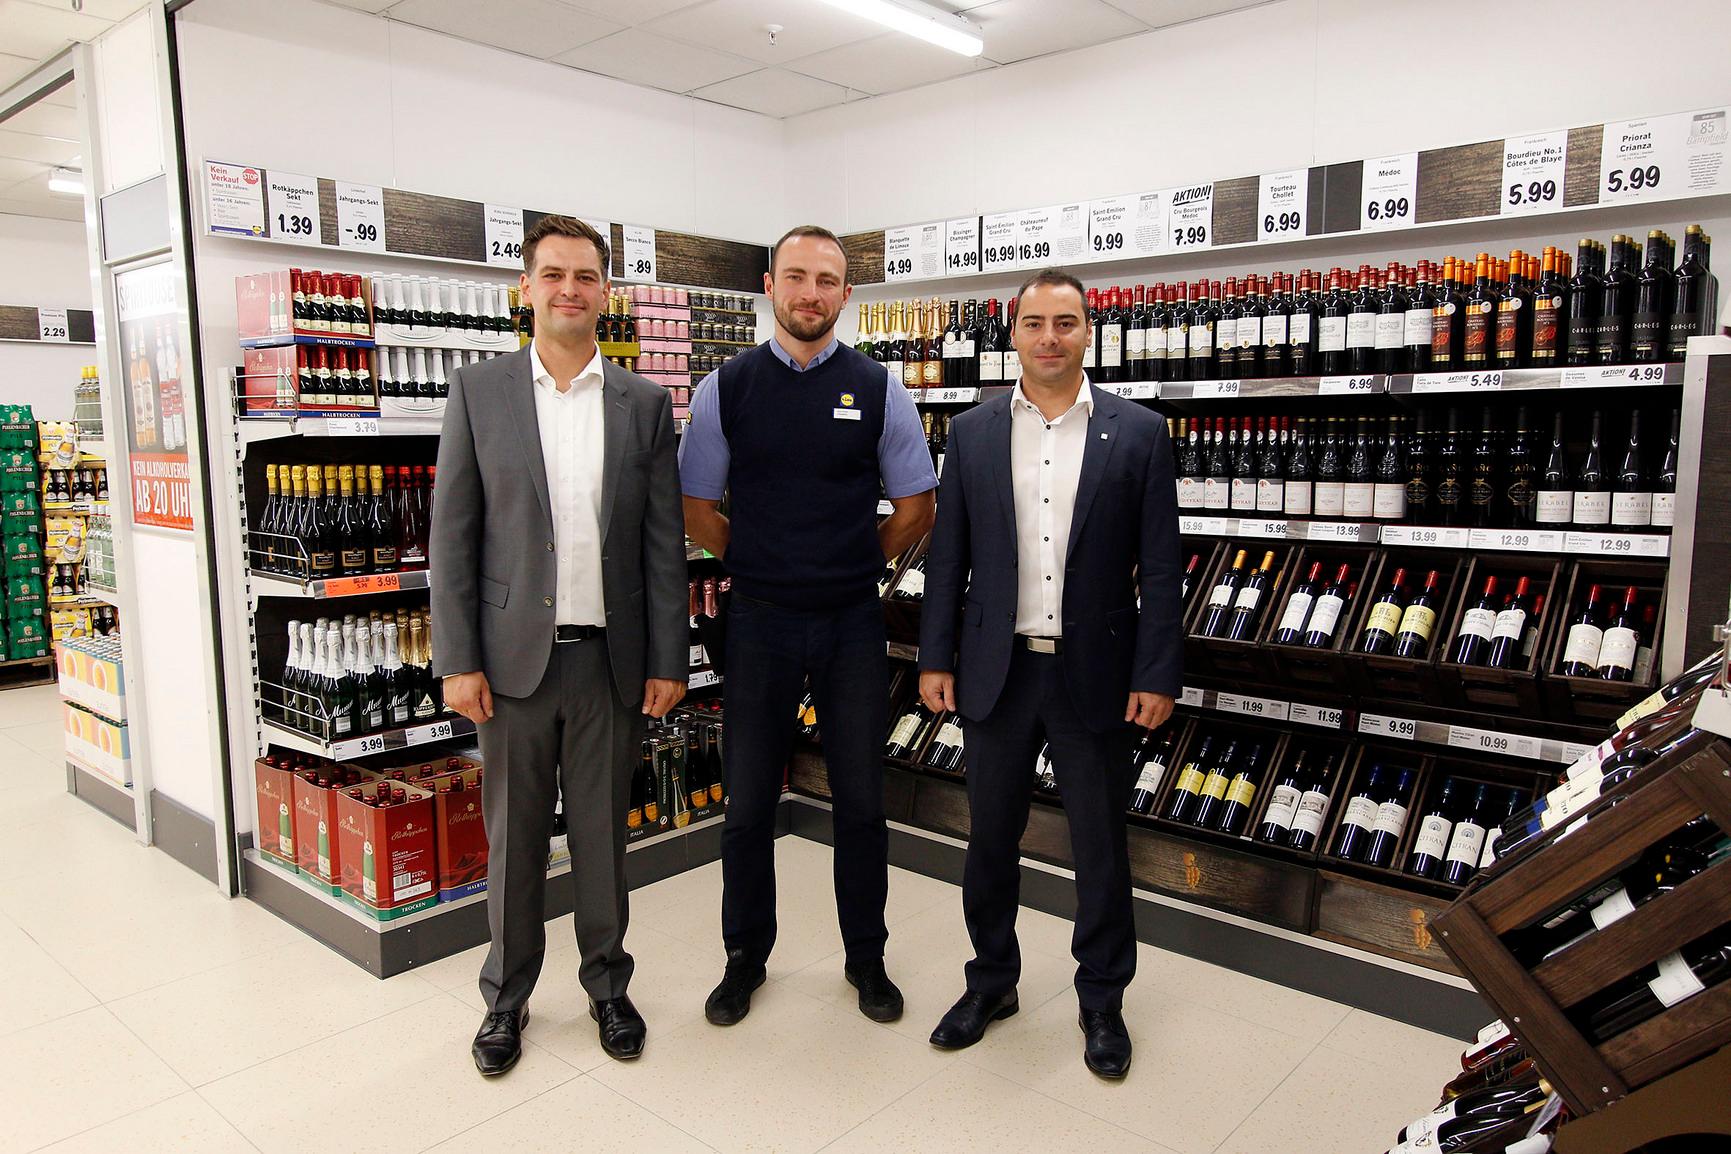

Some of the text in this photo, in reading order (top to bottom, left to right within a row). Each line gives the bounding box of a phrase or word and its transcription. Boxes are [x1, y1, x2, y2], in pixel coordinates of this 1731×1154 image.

[1622, 132, 1652, 142] Priorat
[1620, 143, 1652, 152] Crianza
[1507, 149, 1541, 160] Bourdieu
[1506, 159, 1527, 168] Côtes
[1541, 155, 1562, 164] Blaye
[210, 166, 228, 175] Kein
[210, 174, 240, 184] Verkauf
[1607, 165, 1661, 193] 5.99
[272, 184, 314, 196] Rotkäppchen
[1270, 184, 1297, 192] Tourteau
[1508, 180, 1556, 205] 5.99
[286, 193, 301, 201] Sekt
[1172, 185, 1212, 204] AKTION!
[1272, 191, 1294, 199] Chollet
[1092, 206, 1125, 216] Saint Emilion
[1183, 205, 1208, 214] Bourgeois
[1368, 197, 1409, 220] 6.99
[278, 213, 313, 236] 1.39
[1264, 211, 1300, 233] 6.99
[345, 223, 377, 242] -.99
[1174, 226, 1206, 246] 7.99
[1094, 232, 1123, 251] 9.99
[492, 241, 521, 259] 2.49
[984, 245, 1014, 263] 19.99
[1018, 241, 1050, 260] 16.99
[948, 251, 977, 268] 14.99
[628, 259, 652, 274] -.89
[888, 258, 912, 275] 4.99
[43, 326, 66, 337] 2.29
[317, 338, 355, 346] HALBTROCKEN
[1470, 373, 1501, 387] 5.49
[1628, 367, 1663, 381] 4.99
[1218, 382, 1238, 393] 7.99
[1349, 378, 1373, 390] 6.99
[943, 391, 957, 400] 8.99
[1116, 387, 1132, 397] 7.99
[354, 422, 377, 433] 3.79
[136, 479, 151, 513] AB
[153, 480, 168, 515] 20
[1183, 521, 1203, 531] 15.99
[1264, 523, 1287, 533] 15.99
[1336, 525, 1360, 536] 13.99
[1411, 531, 1437, 541] 13.99
[1500, 535, 1529, 546] 12.99
[1600, 539, 1631, 551] 12.99
[377, 575, 397, 587] 3.99
[1242, 700, 1263, 713] 11.99
[1317, 709, 1341, 724] 11.99
[430, 724, 451, 738] 3.99
[1388, 720, 1414, 735] 9.99
[360, 738, 383, 752] 3.99
[1479, 735, 1508, 750] 10.99
[402, 902, 426, 913] TROCKEN
